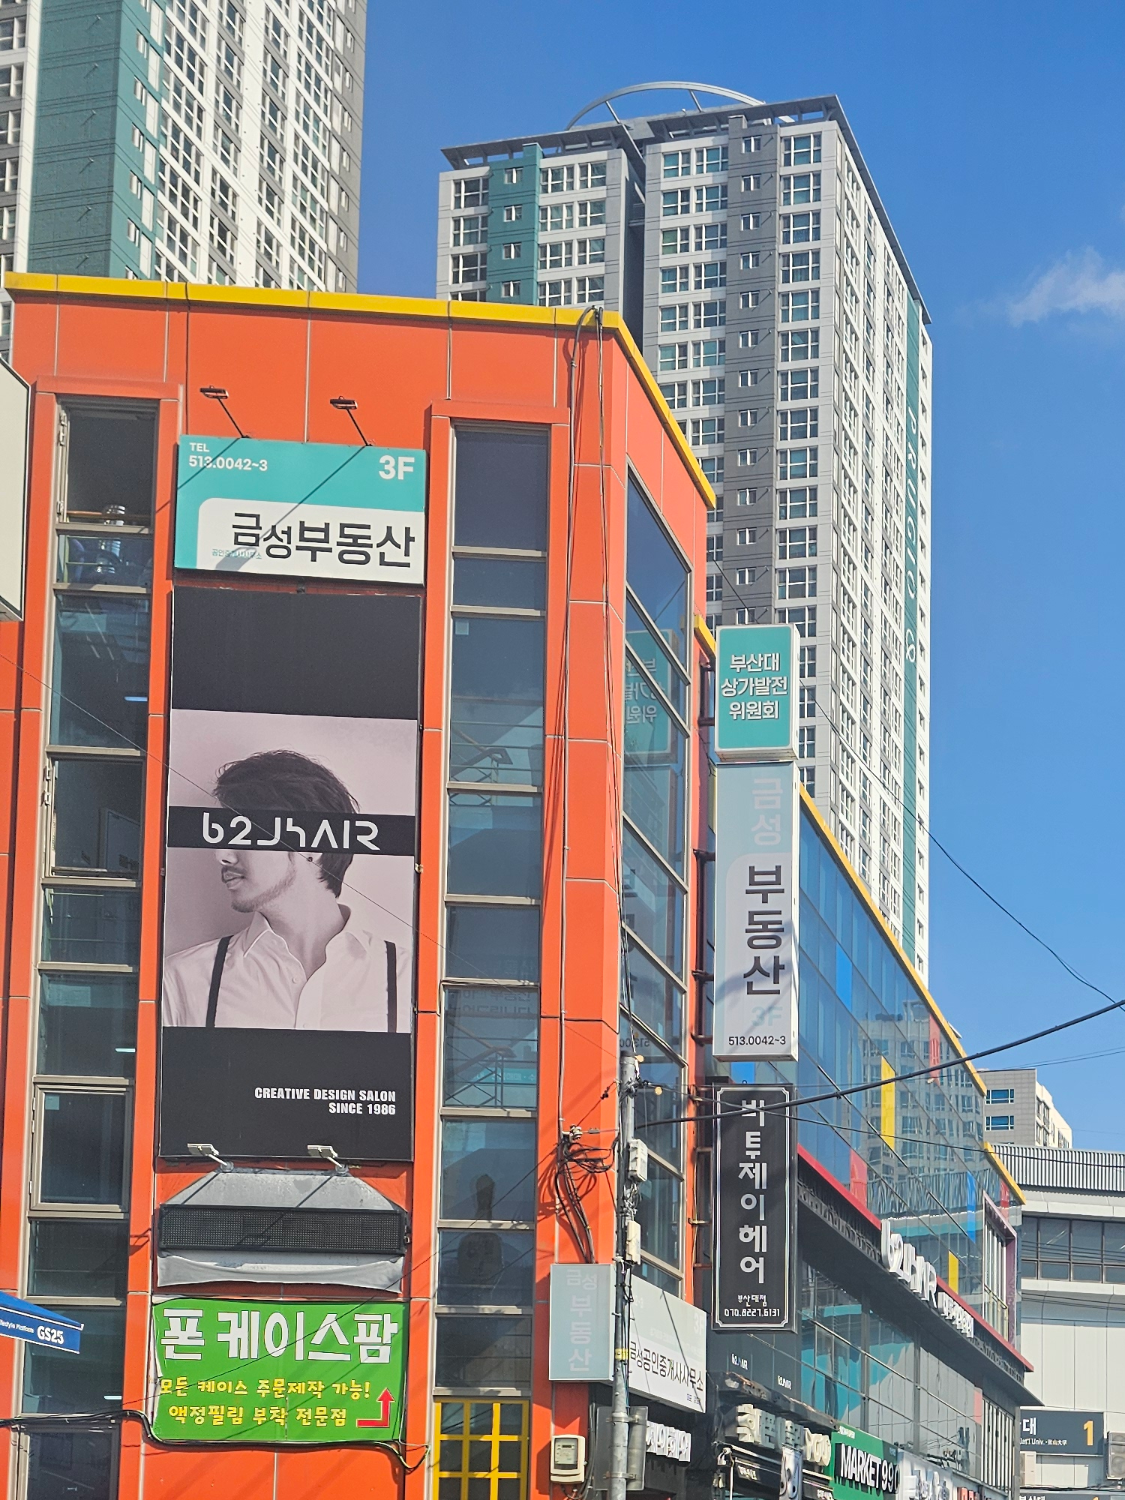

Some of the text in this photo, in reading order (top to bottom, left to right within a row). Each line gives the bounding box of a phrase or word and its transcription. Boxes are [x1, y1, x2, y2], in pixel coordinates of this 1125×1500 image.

[189, 442, 210, 453] TEL
[188, 455, 268, 471] 513.0042~3
[378, 454, 415, 480] 3F
[231, 512, 416, 568] 금성부동산
[729, 653, 781, 673] 부산대
[720, 676, 789, 697] 상가발전
[728, 700, 780, 720] 위원회
[751, 777, 782, 845] 금성
[742, 863, 785, 995] 부동산
[751, 1005, 783, 1028] 3F
[728, 1035, 787, 1047] 513.0042~3
[254, 1087, 396, 1102] CREATIVE DESIGN SALON
[328, 1102, 396, 1115] SINCE 1986
[37, 1326, 64, 1344] GS25
[161, 1309, 399, 1364] 폰 케이스팜
[568, 1295, 593, 1372] 부동산
[159, 1376, 371, 1400] 모든 케이스 주문제작 가능!
[168, 1405, 348, 1427] 액정필림 부착 전문점
[1083, 1420, 1094, 1446] 1
[839, 1443, 883, 1490] MARKET
